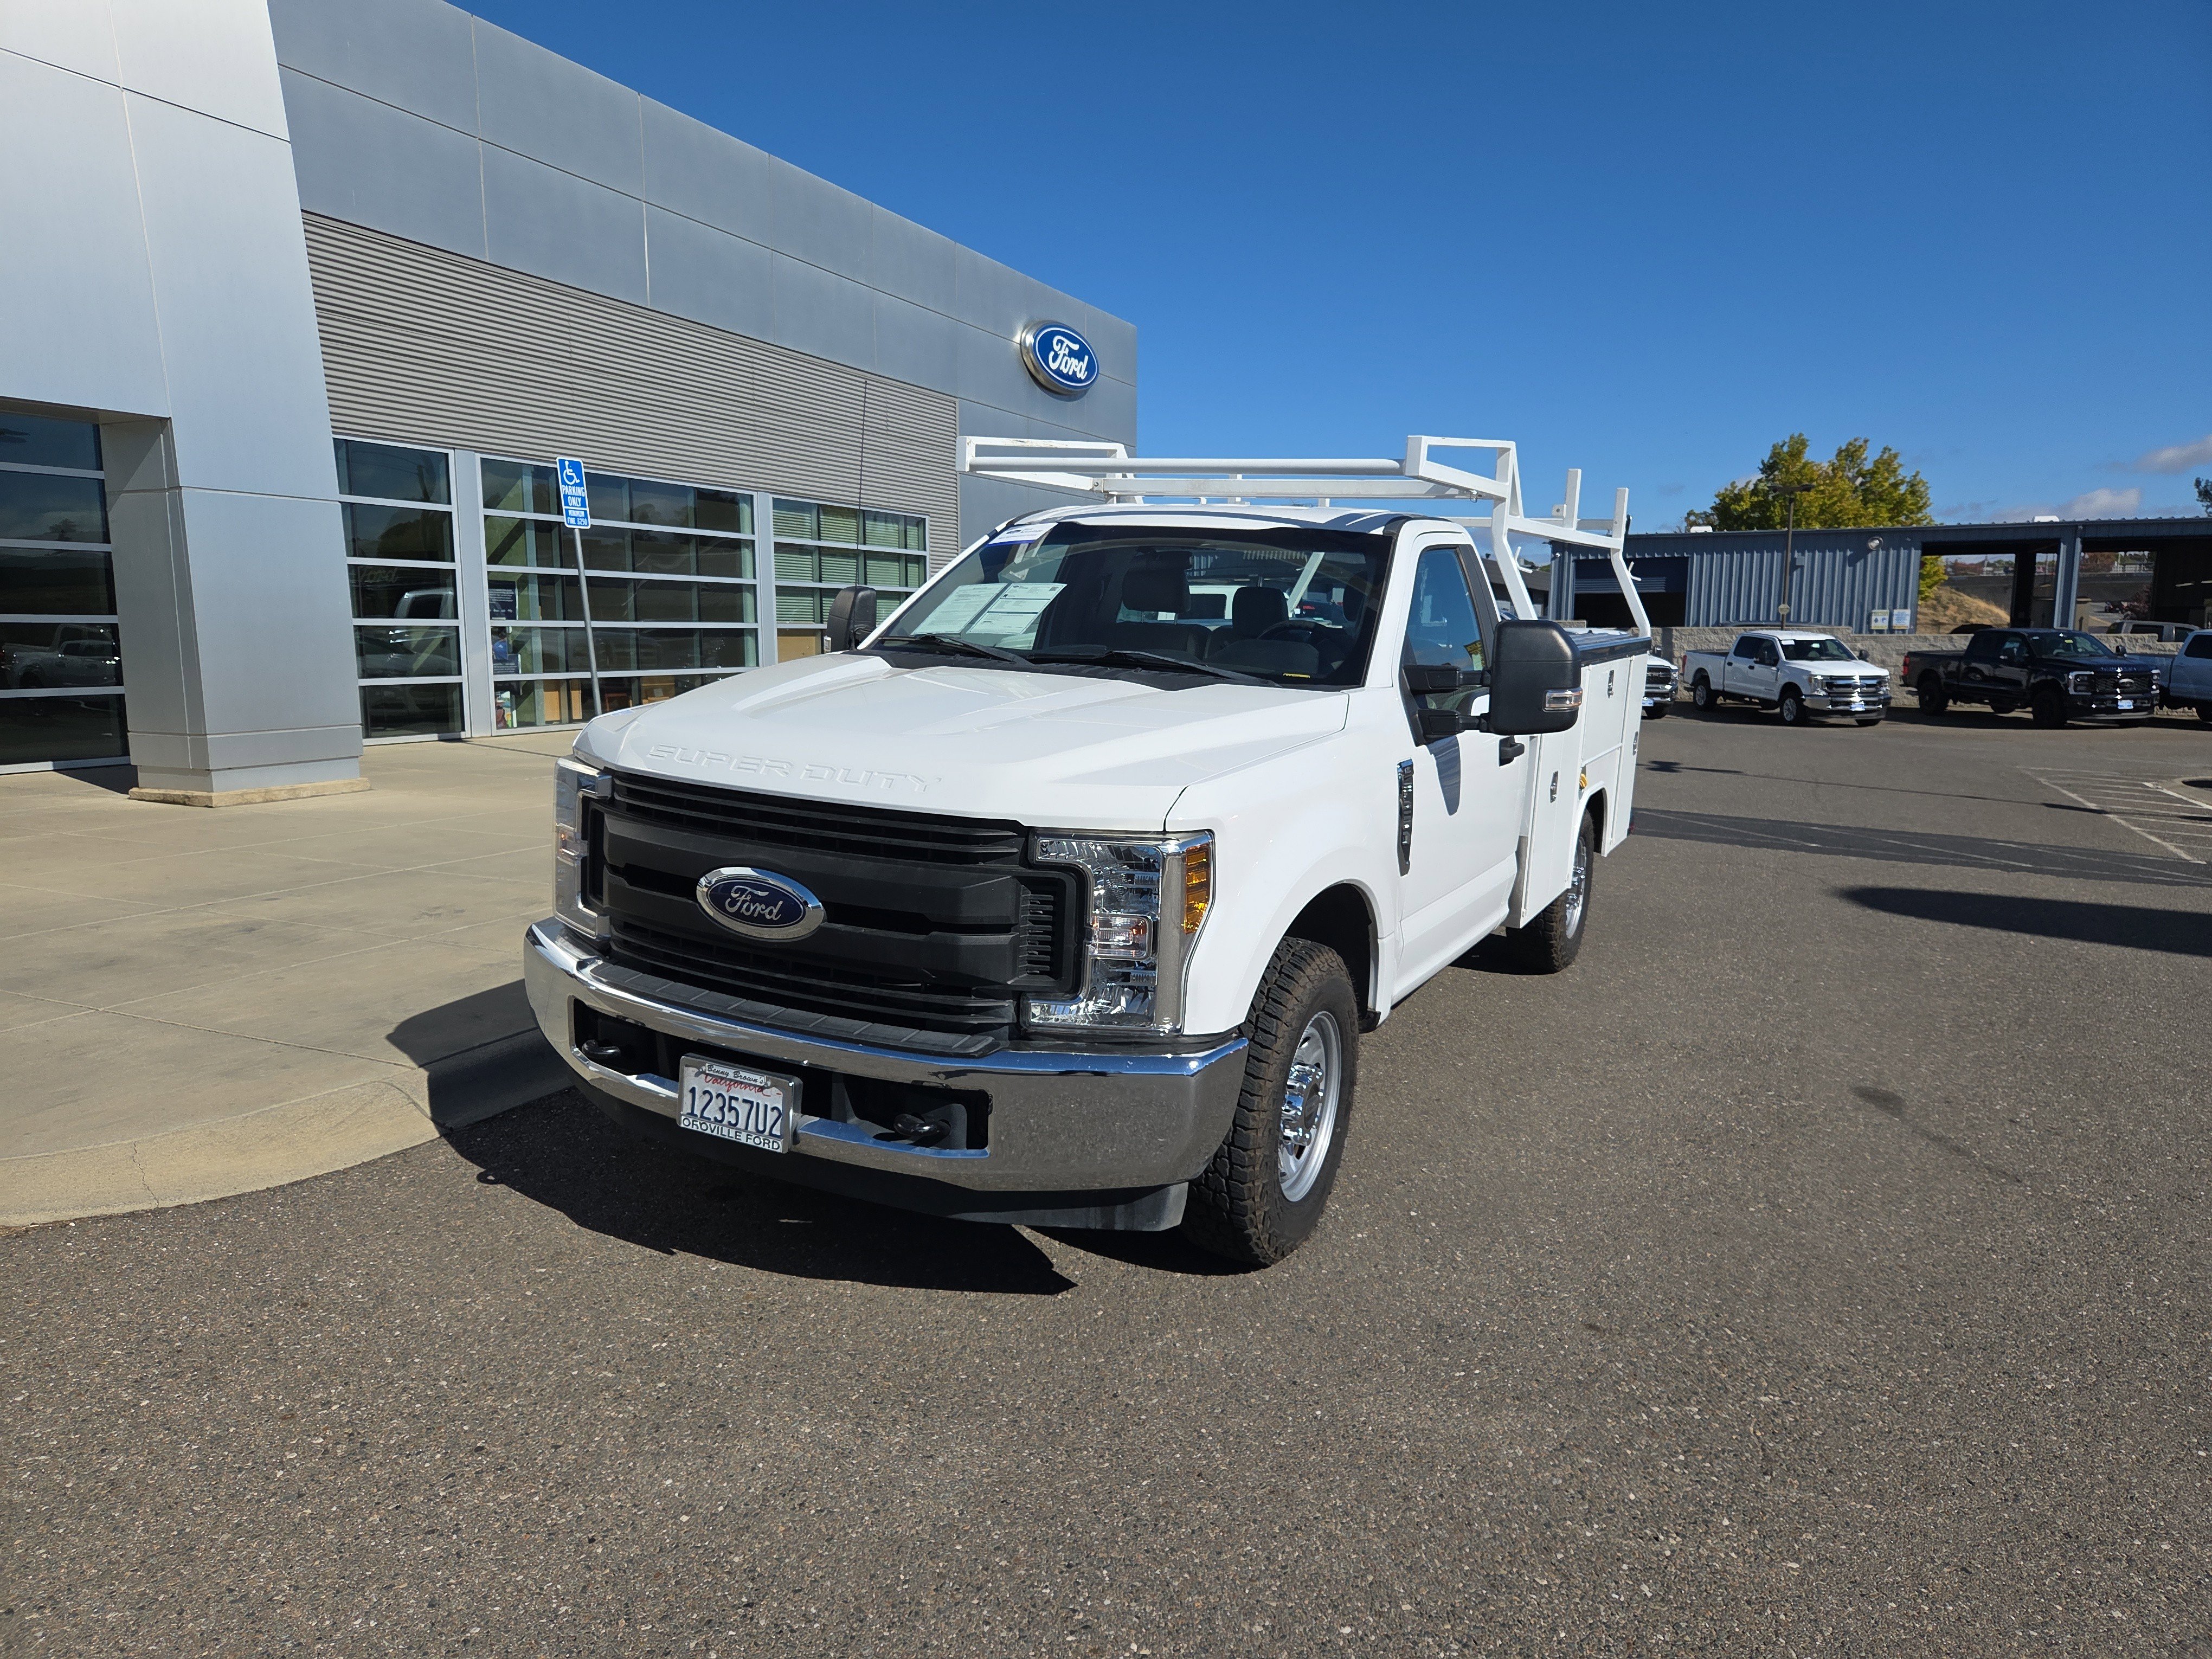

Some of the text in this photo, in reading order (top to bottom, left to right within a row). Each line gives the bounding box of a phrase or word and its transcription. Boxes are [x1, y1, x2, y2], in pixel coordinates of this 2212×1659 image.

[1049, 335, 1089, 380] Ford
[562, 485, 585, 497] PARKING
[568, 496, 582, 507] ONLY
[647, 743, 943, 793] SUPER DUTY
[725, 885, 783, 921] Ford
[707, 1064, 764, 1084] Benny Brown's
[686, 1086, 782, 1139] 12357U2
[682, 1117, 780, 1150] OROVILLE FORD
